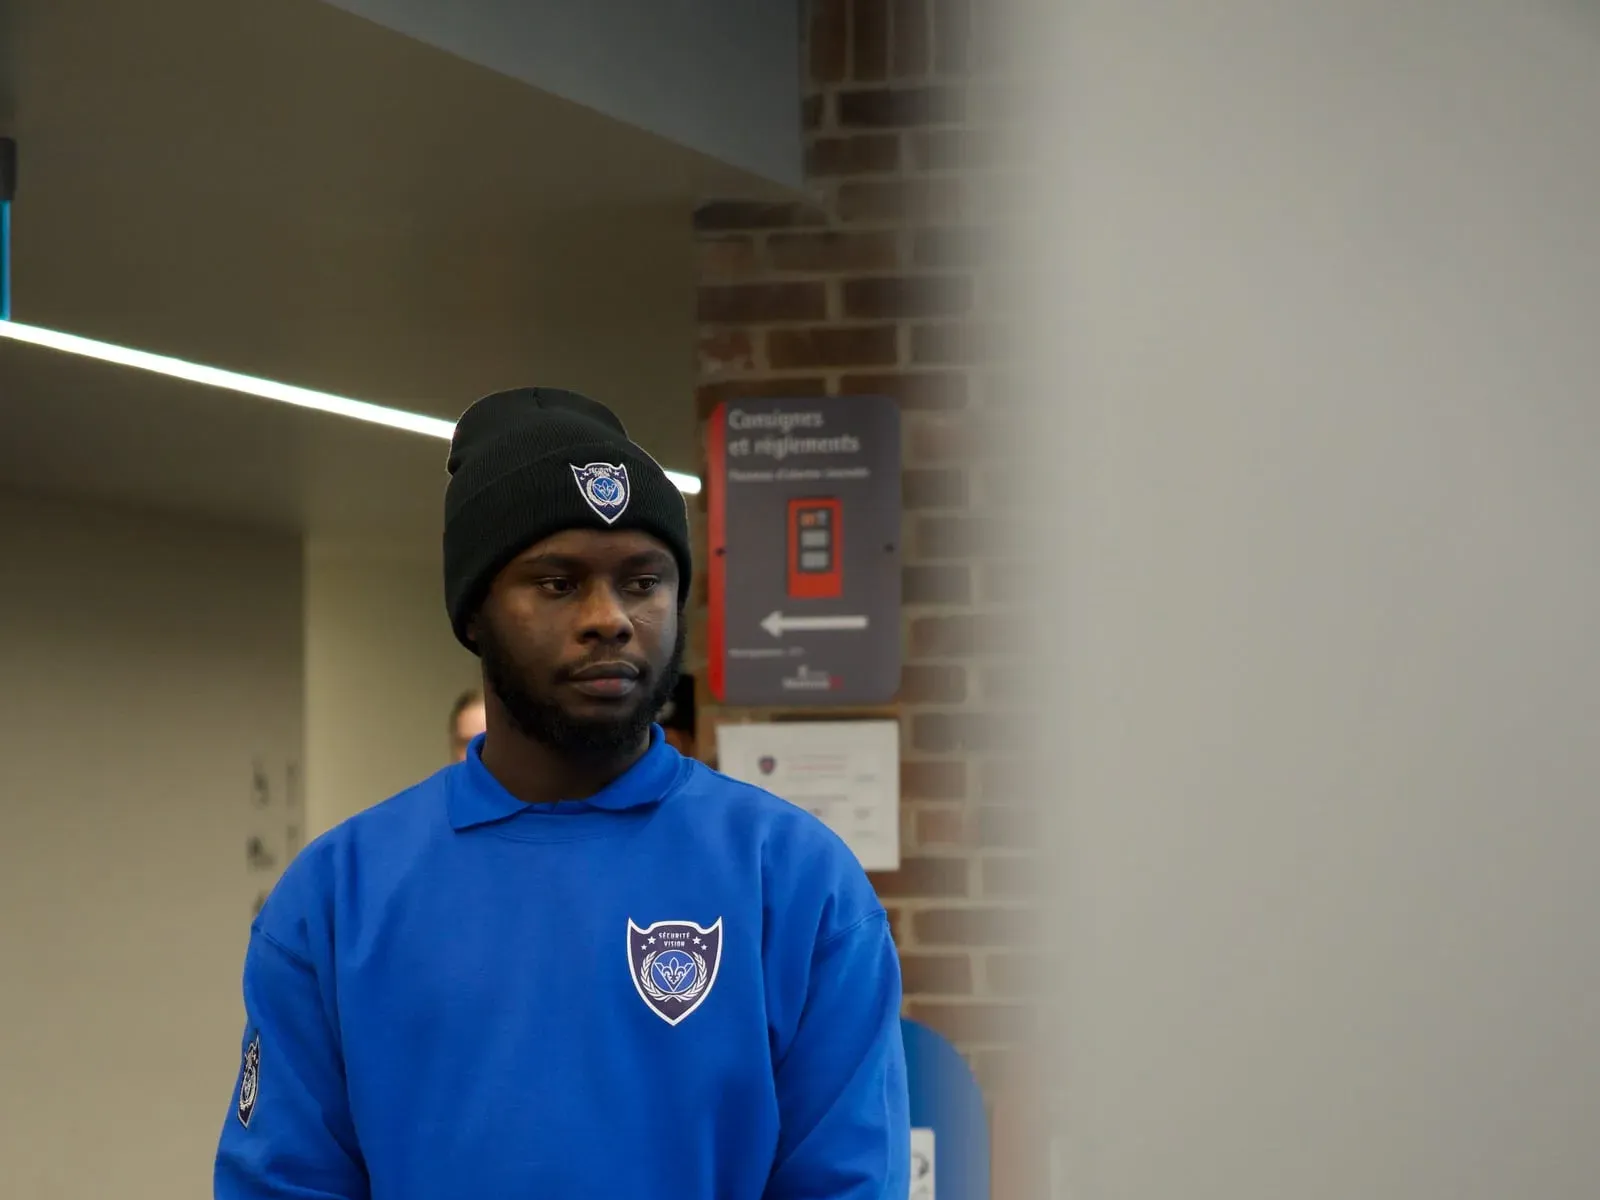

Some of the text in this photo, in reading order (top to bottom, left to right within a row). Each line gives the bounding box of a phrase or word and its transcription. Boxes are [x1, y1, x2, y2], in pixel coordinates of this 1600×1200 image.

[728, 408, 823, 432] Consignes
[728, 439, 750, 456] et
[658, 931, 690, 939] SÉCURITÉ
